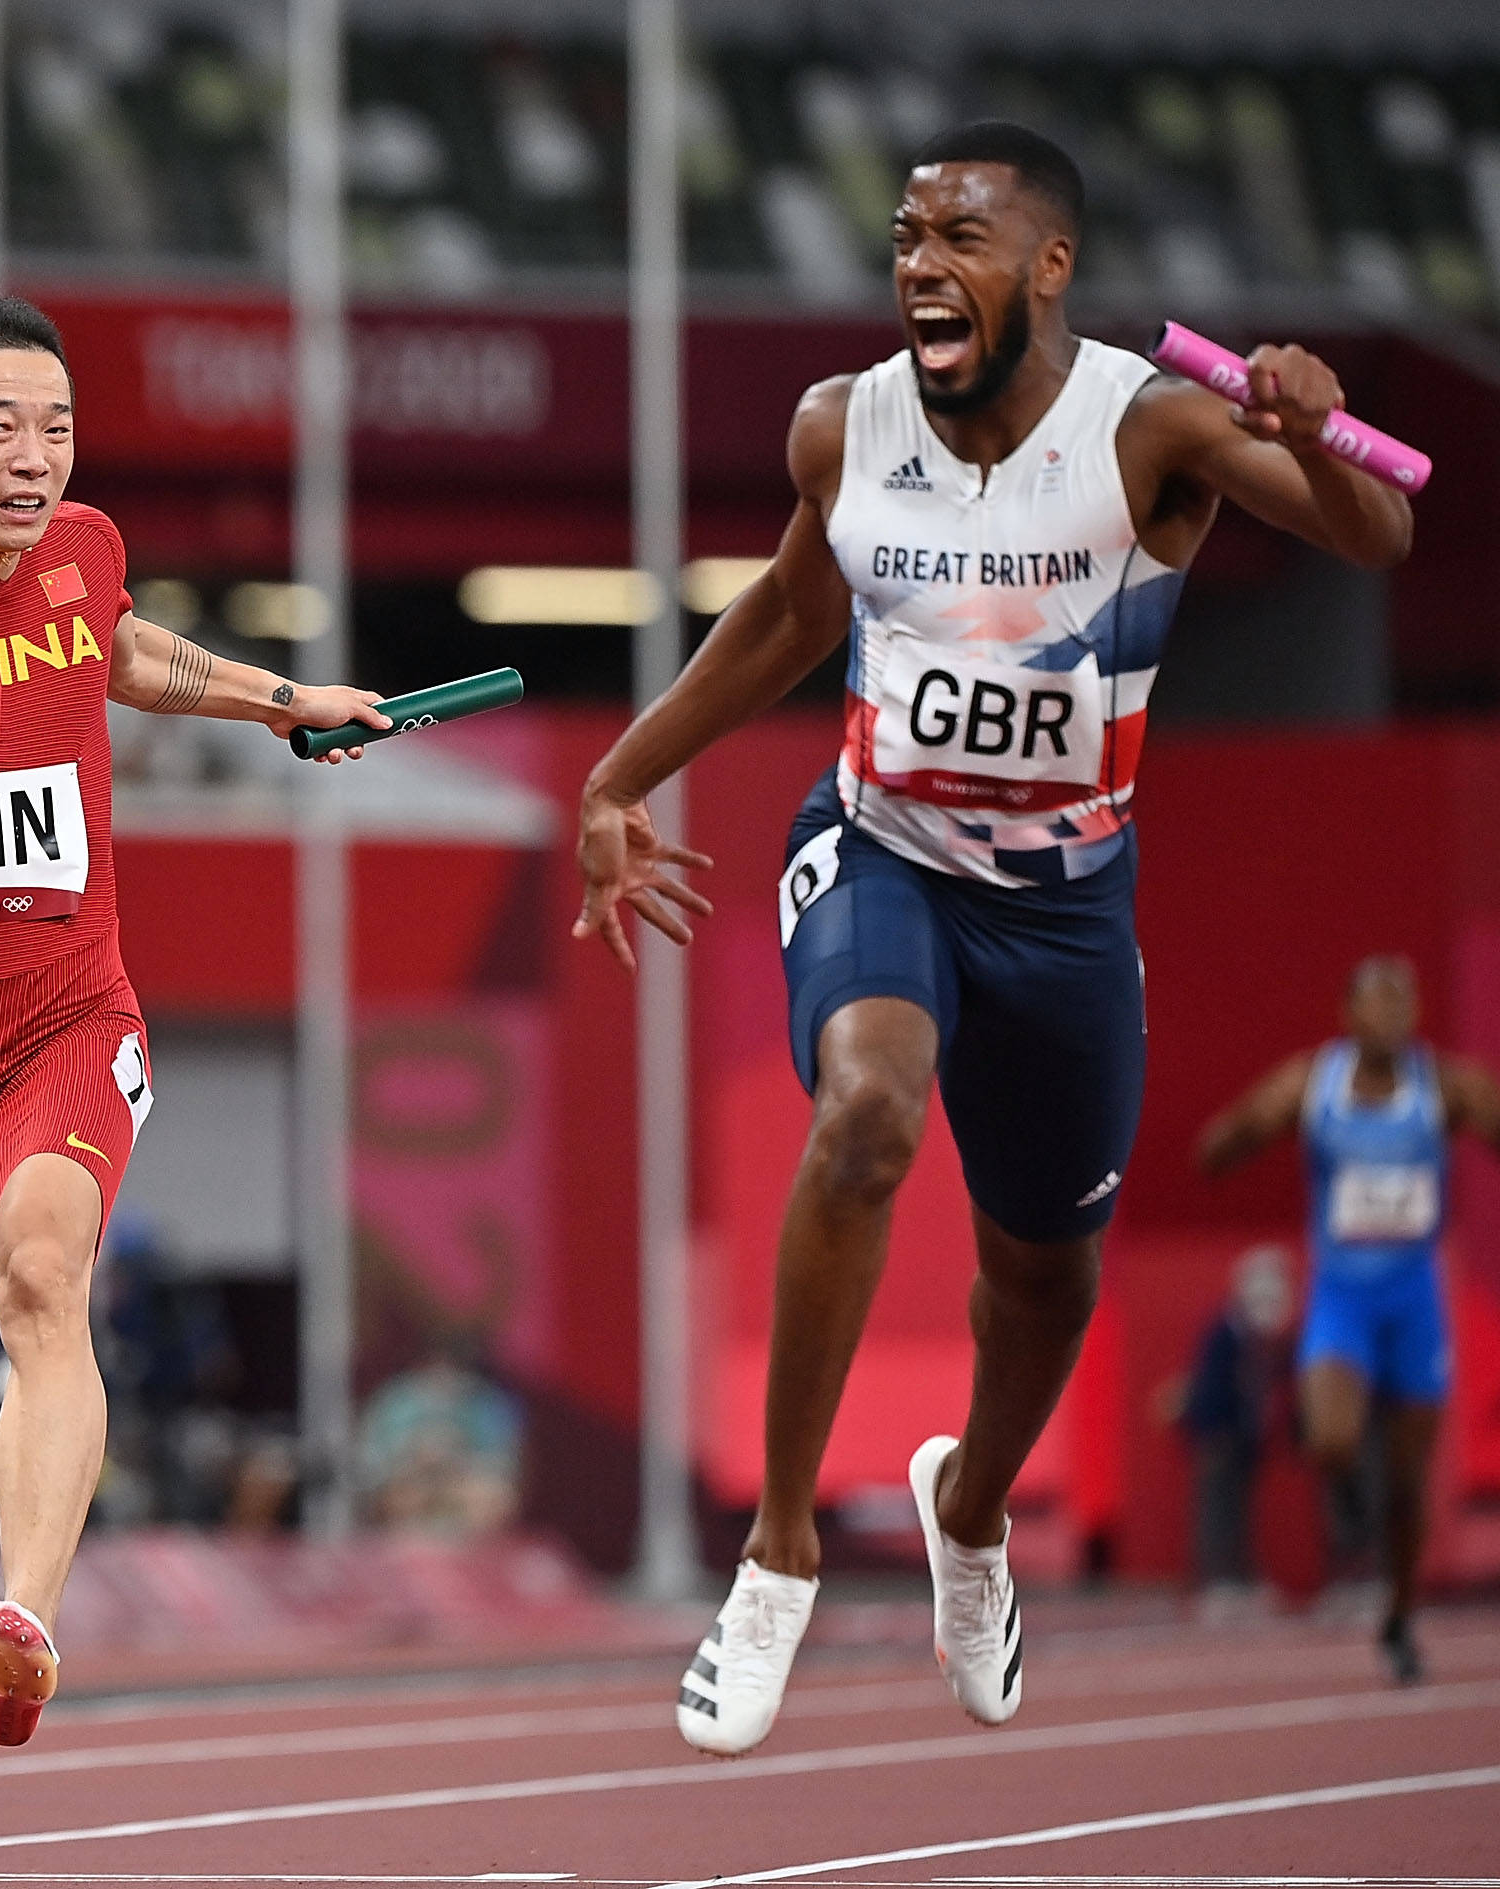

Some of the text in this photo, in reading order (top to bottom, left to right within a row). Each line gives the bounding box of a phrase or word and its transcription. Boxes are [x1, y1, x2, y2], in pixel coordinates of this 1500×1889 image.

[873, 545, 1092, 588] GREAT BRITAIN
[910, 668, 1073, 759] GBR
